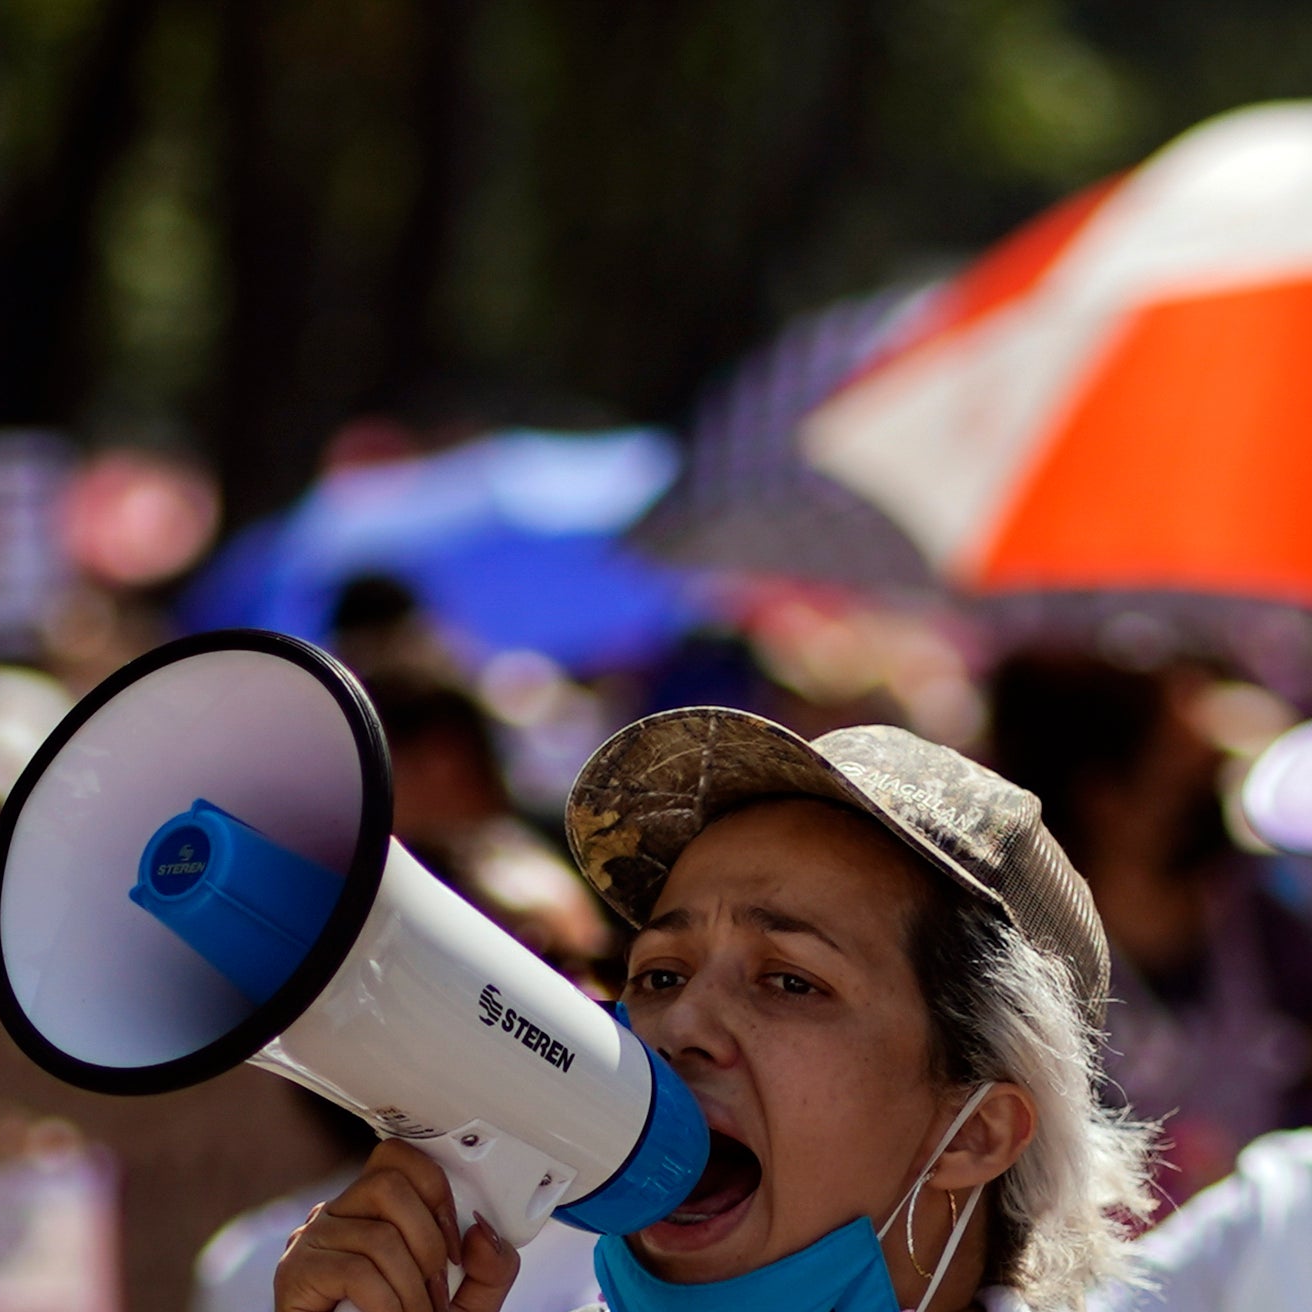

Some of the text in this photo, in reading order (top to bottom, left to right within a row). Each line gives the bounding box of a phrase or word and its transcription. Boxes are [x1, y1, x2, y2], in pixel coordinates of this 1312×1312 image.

[862, 771, 975, 832] MAGELLAN
[157, 862, 206, 875] STEREN
[501, 1008, 575, 1073] STEREN
